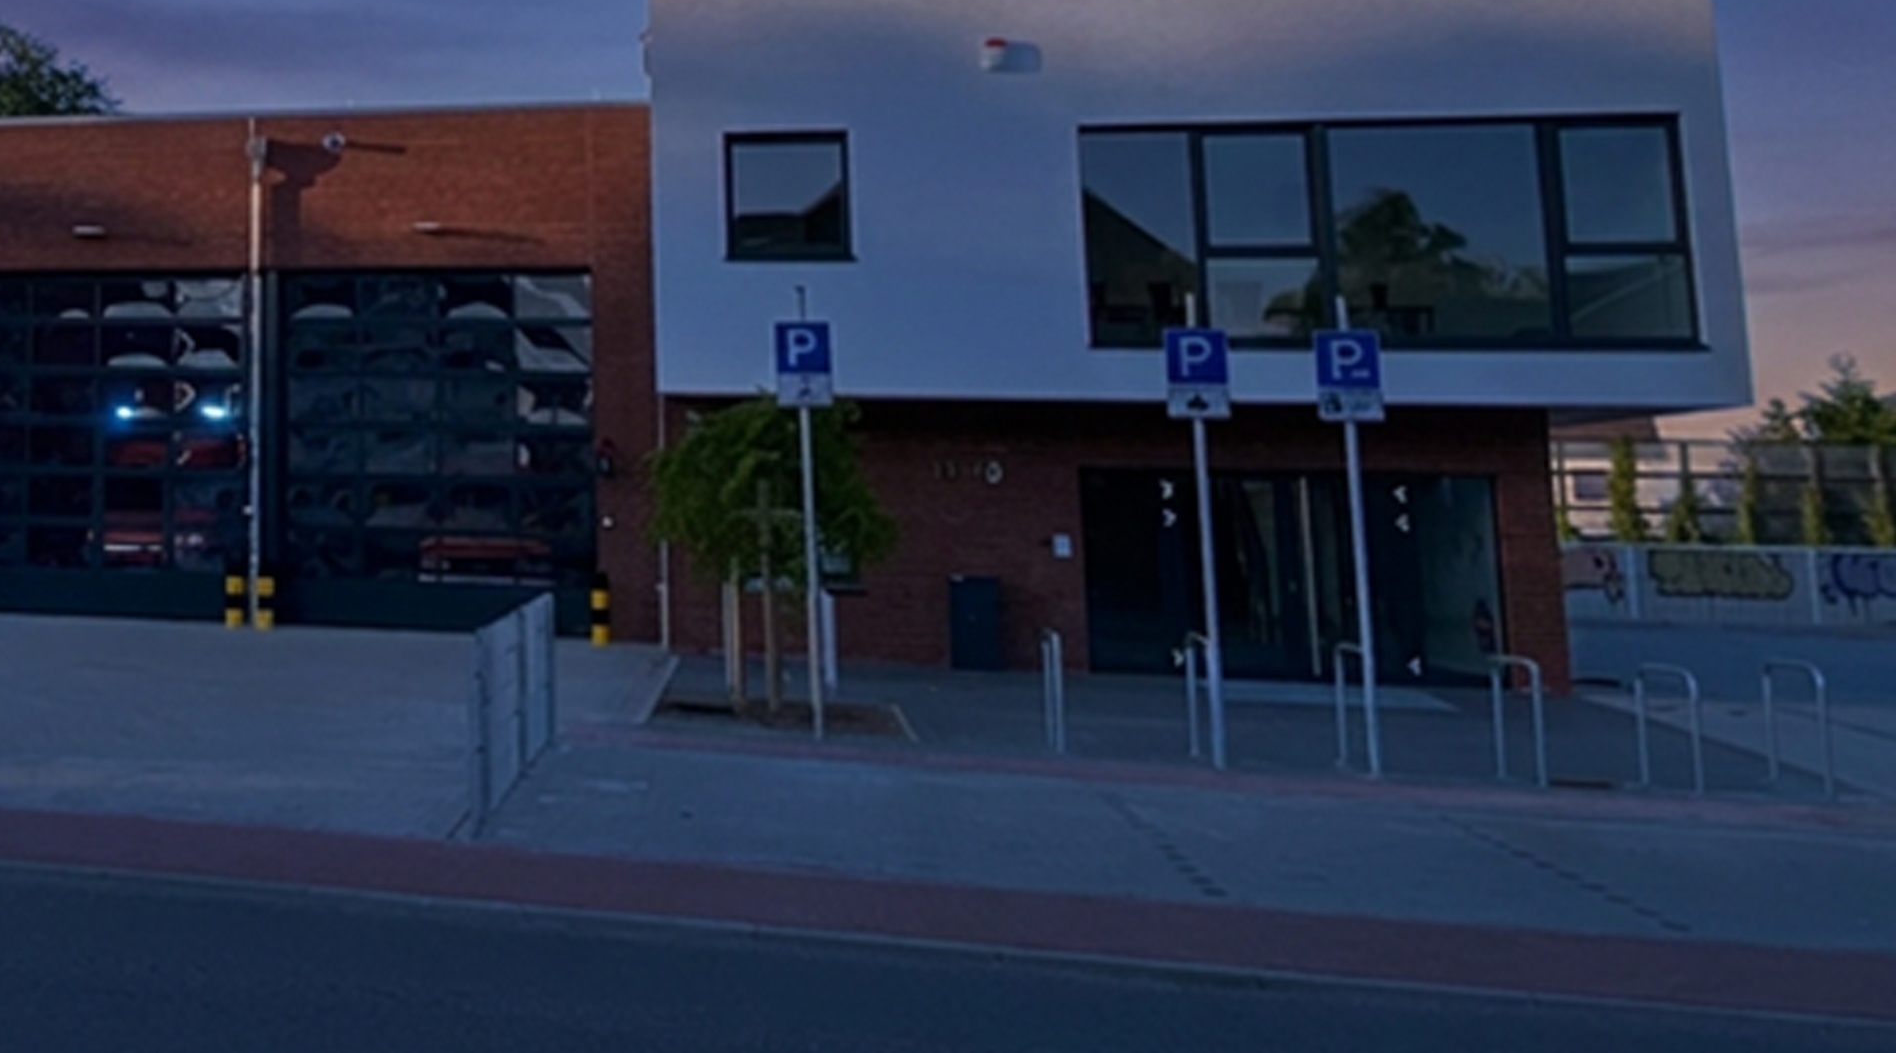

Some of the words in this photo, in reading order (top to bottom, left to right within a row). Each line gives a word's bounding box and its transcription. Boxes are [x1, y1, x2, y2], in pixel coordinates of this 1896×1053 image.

[786, 327, 817, 368] P
[1177, 334, 1213, 378] P
[1329, 338, 1365, 381] P
